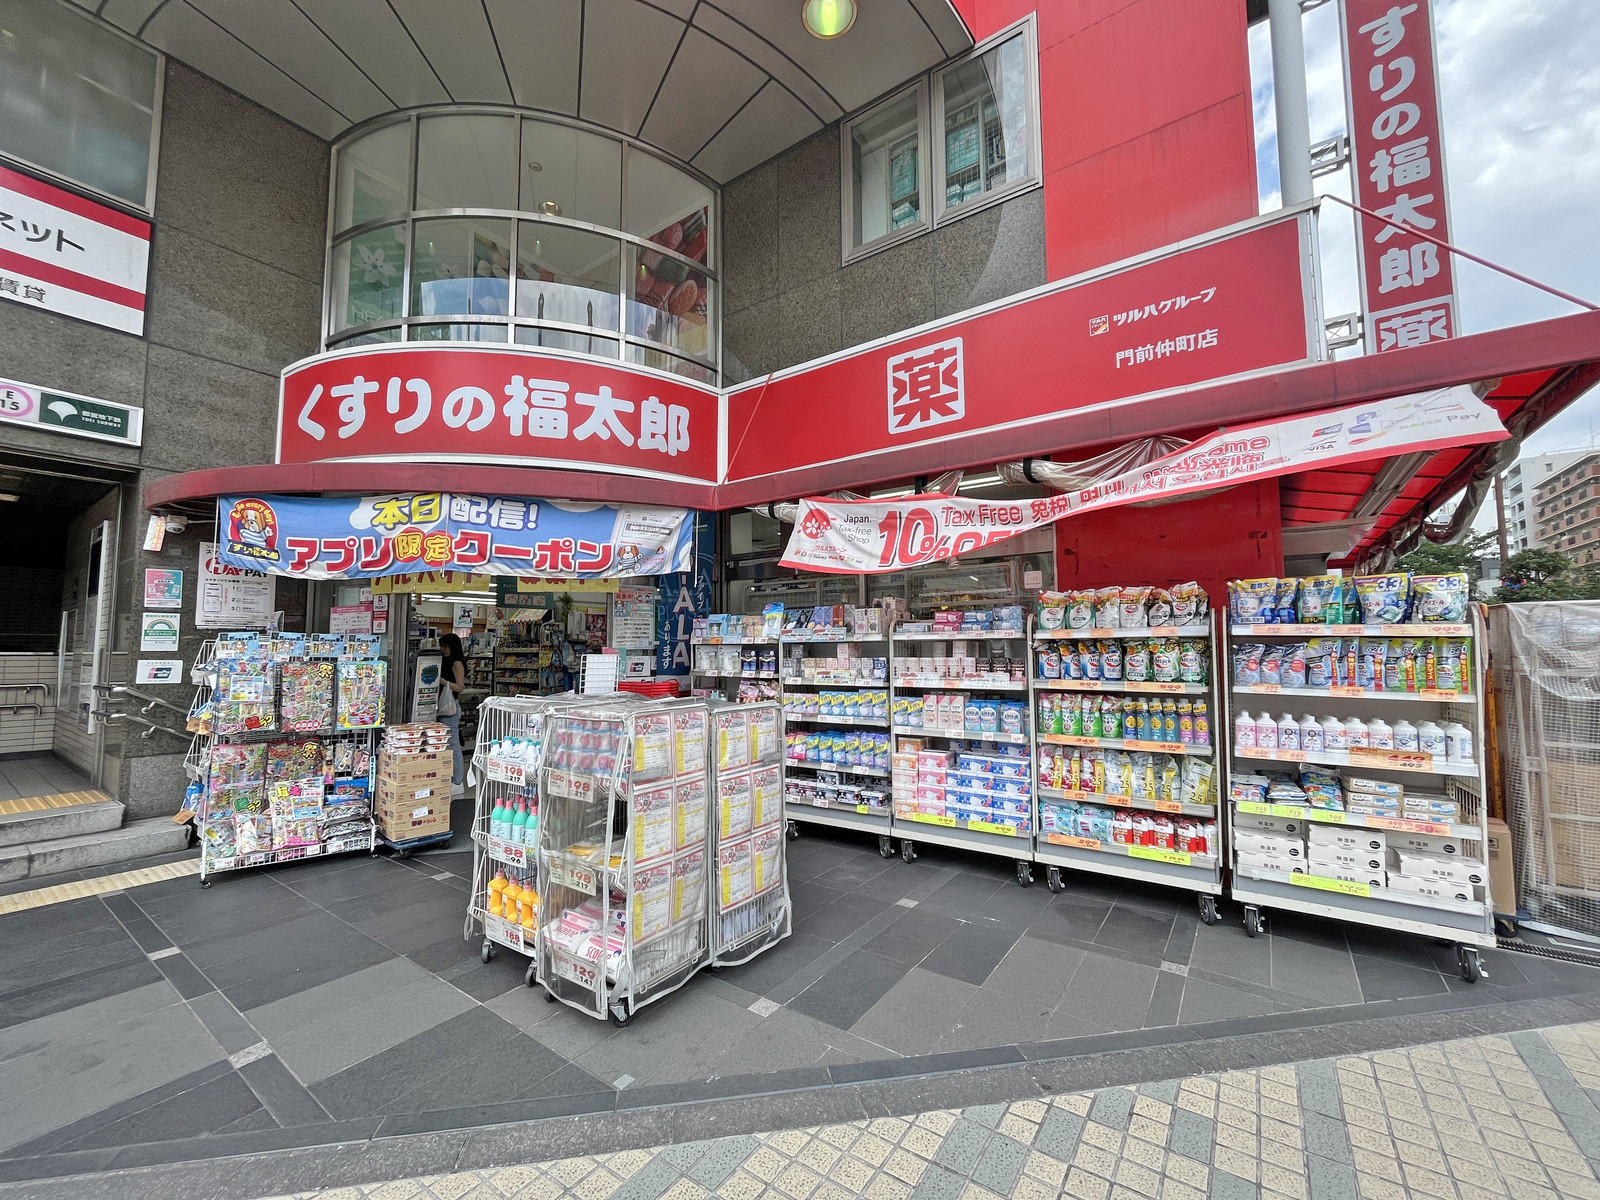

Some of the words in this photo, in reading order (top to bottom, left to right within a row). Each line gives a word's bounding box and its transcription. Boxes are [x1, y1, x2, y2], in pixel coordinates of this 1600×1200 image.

[1358, 3, 1440, 294] すりの福太郎
[1112, 286, 1217, 326] ツルハグループ
[1115, 328, 1219, 369] 門前仲町店
[892, 346, 959, 428] 薬
[6, 390, 14, 399] E
[297, 375, 690, 456] くすりの福太郎
[1446, 412, 1481, 424] Pay
[1308, 444, 1334, 452] VISA
[373, 492, 538, 530] 本日配信!
[942, 505, 975, 527] Tax
[978, 504, 1023, 527] Free
[843, 514, 873, 526] Japan.
[837, 524, 873, 536] Tax-free
[847, 534, 871, 545] Shop
[287, 527, 612, 573] アプリ限定クーポン
[503, 765, 523, 777] 198
[567, 779, 590, 792] 198
[503, 847, 524, 859] 88
[568, 868, 592, 884] 198
[575, 881, 588, 890] 217
[503, 929, 521, 942] 188
[572, 963, 596, 979] 129
[579, 975, 593, 985] 141
